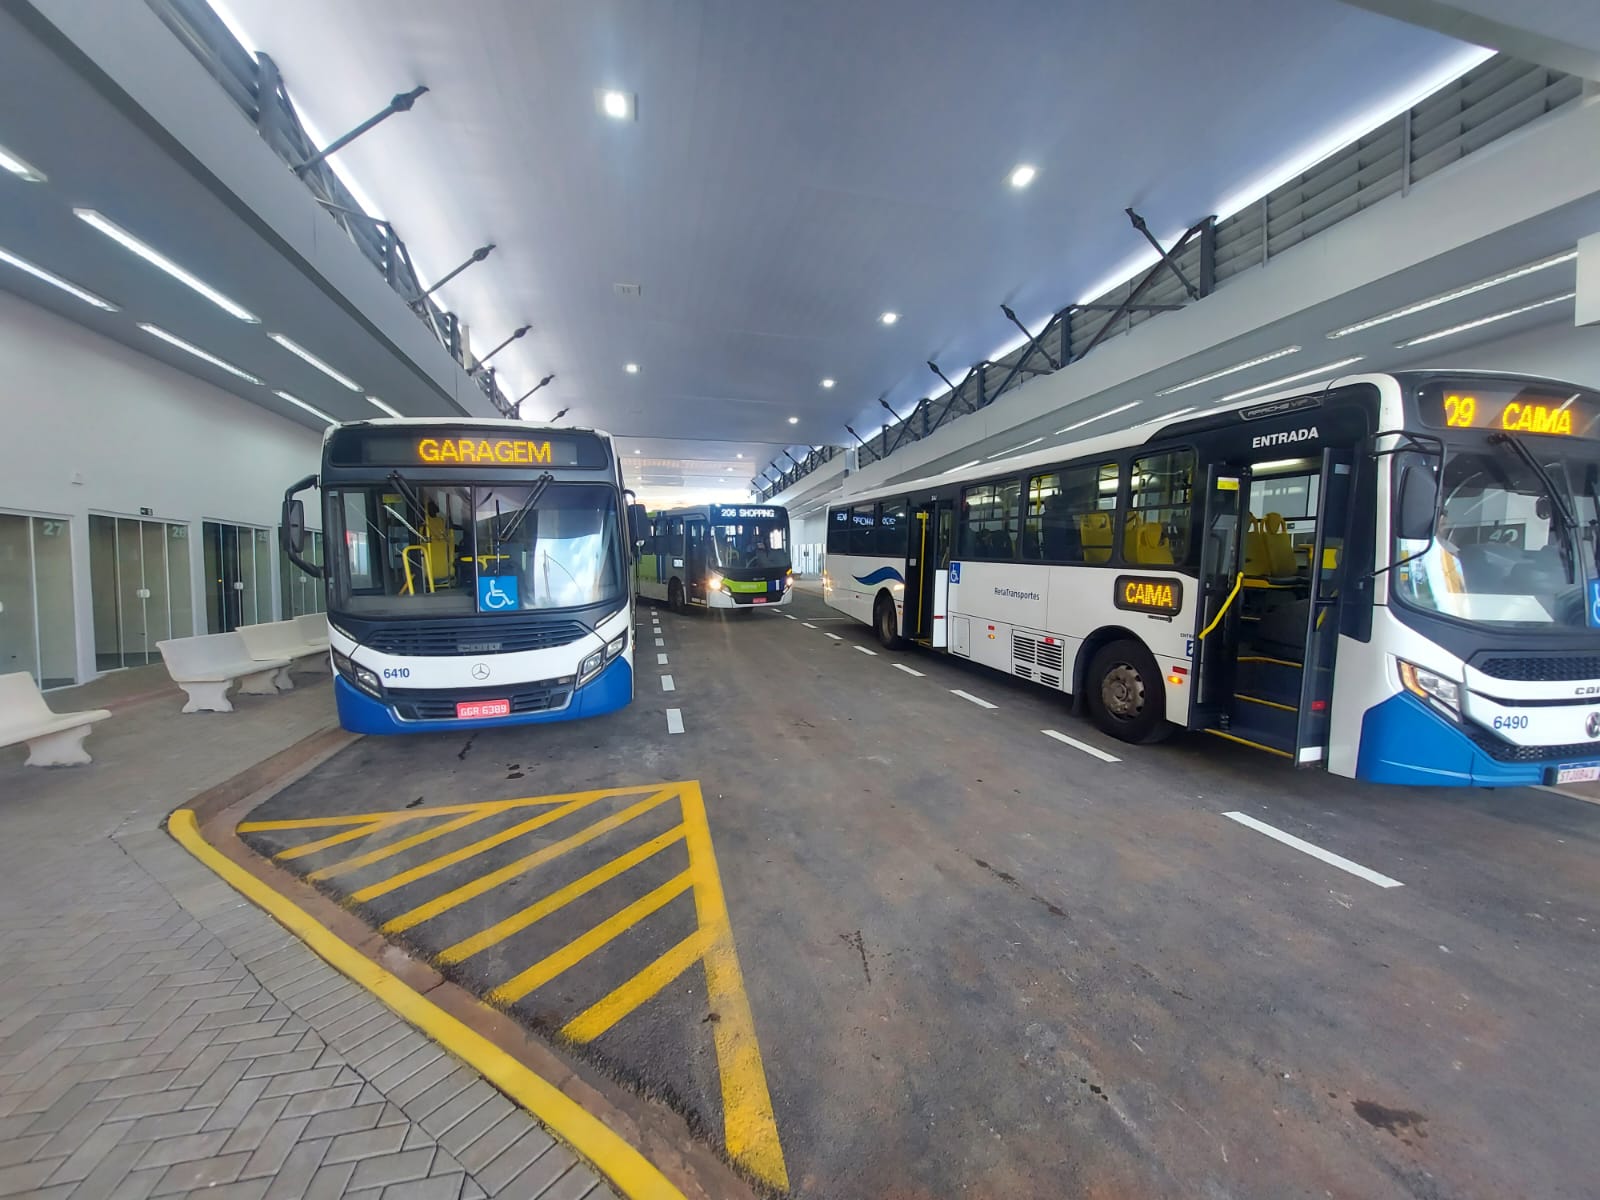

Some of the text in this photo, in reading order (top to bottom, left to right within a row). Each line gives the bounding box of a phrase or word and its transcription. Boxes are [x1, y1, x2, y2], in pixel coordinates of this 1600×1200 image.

[1502, 402, 1571, 435] CAIMA
[1252, 426, 1319, 449] ENTRADA
[418, 439, 552, 463] GARAGEM
[721, 508, 775, 518] 206 SHOPPING
[43, 521, 63, 537] 27
[1125, 582, 1173, 607] CAIMA
[383, 667, 410, 679] 6410
[460, 704, 507, 717] GGR 6389
[1493, 715, 1529, 730] 6490
